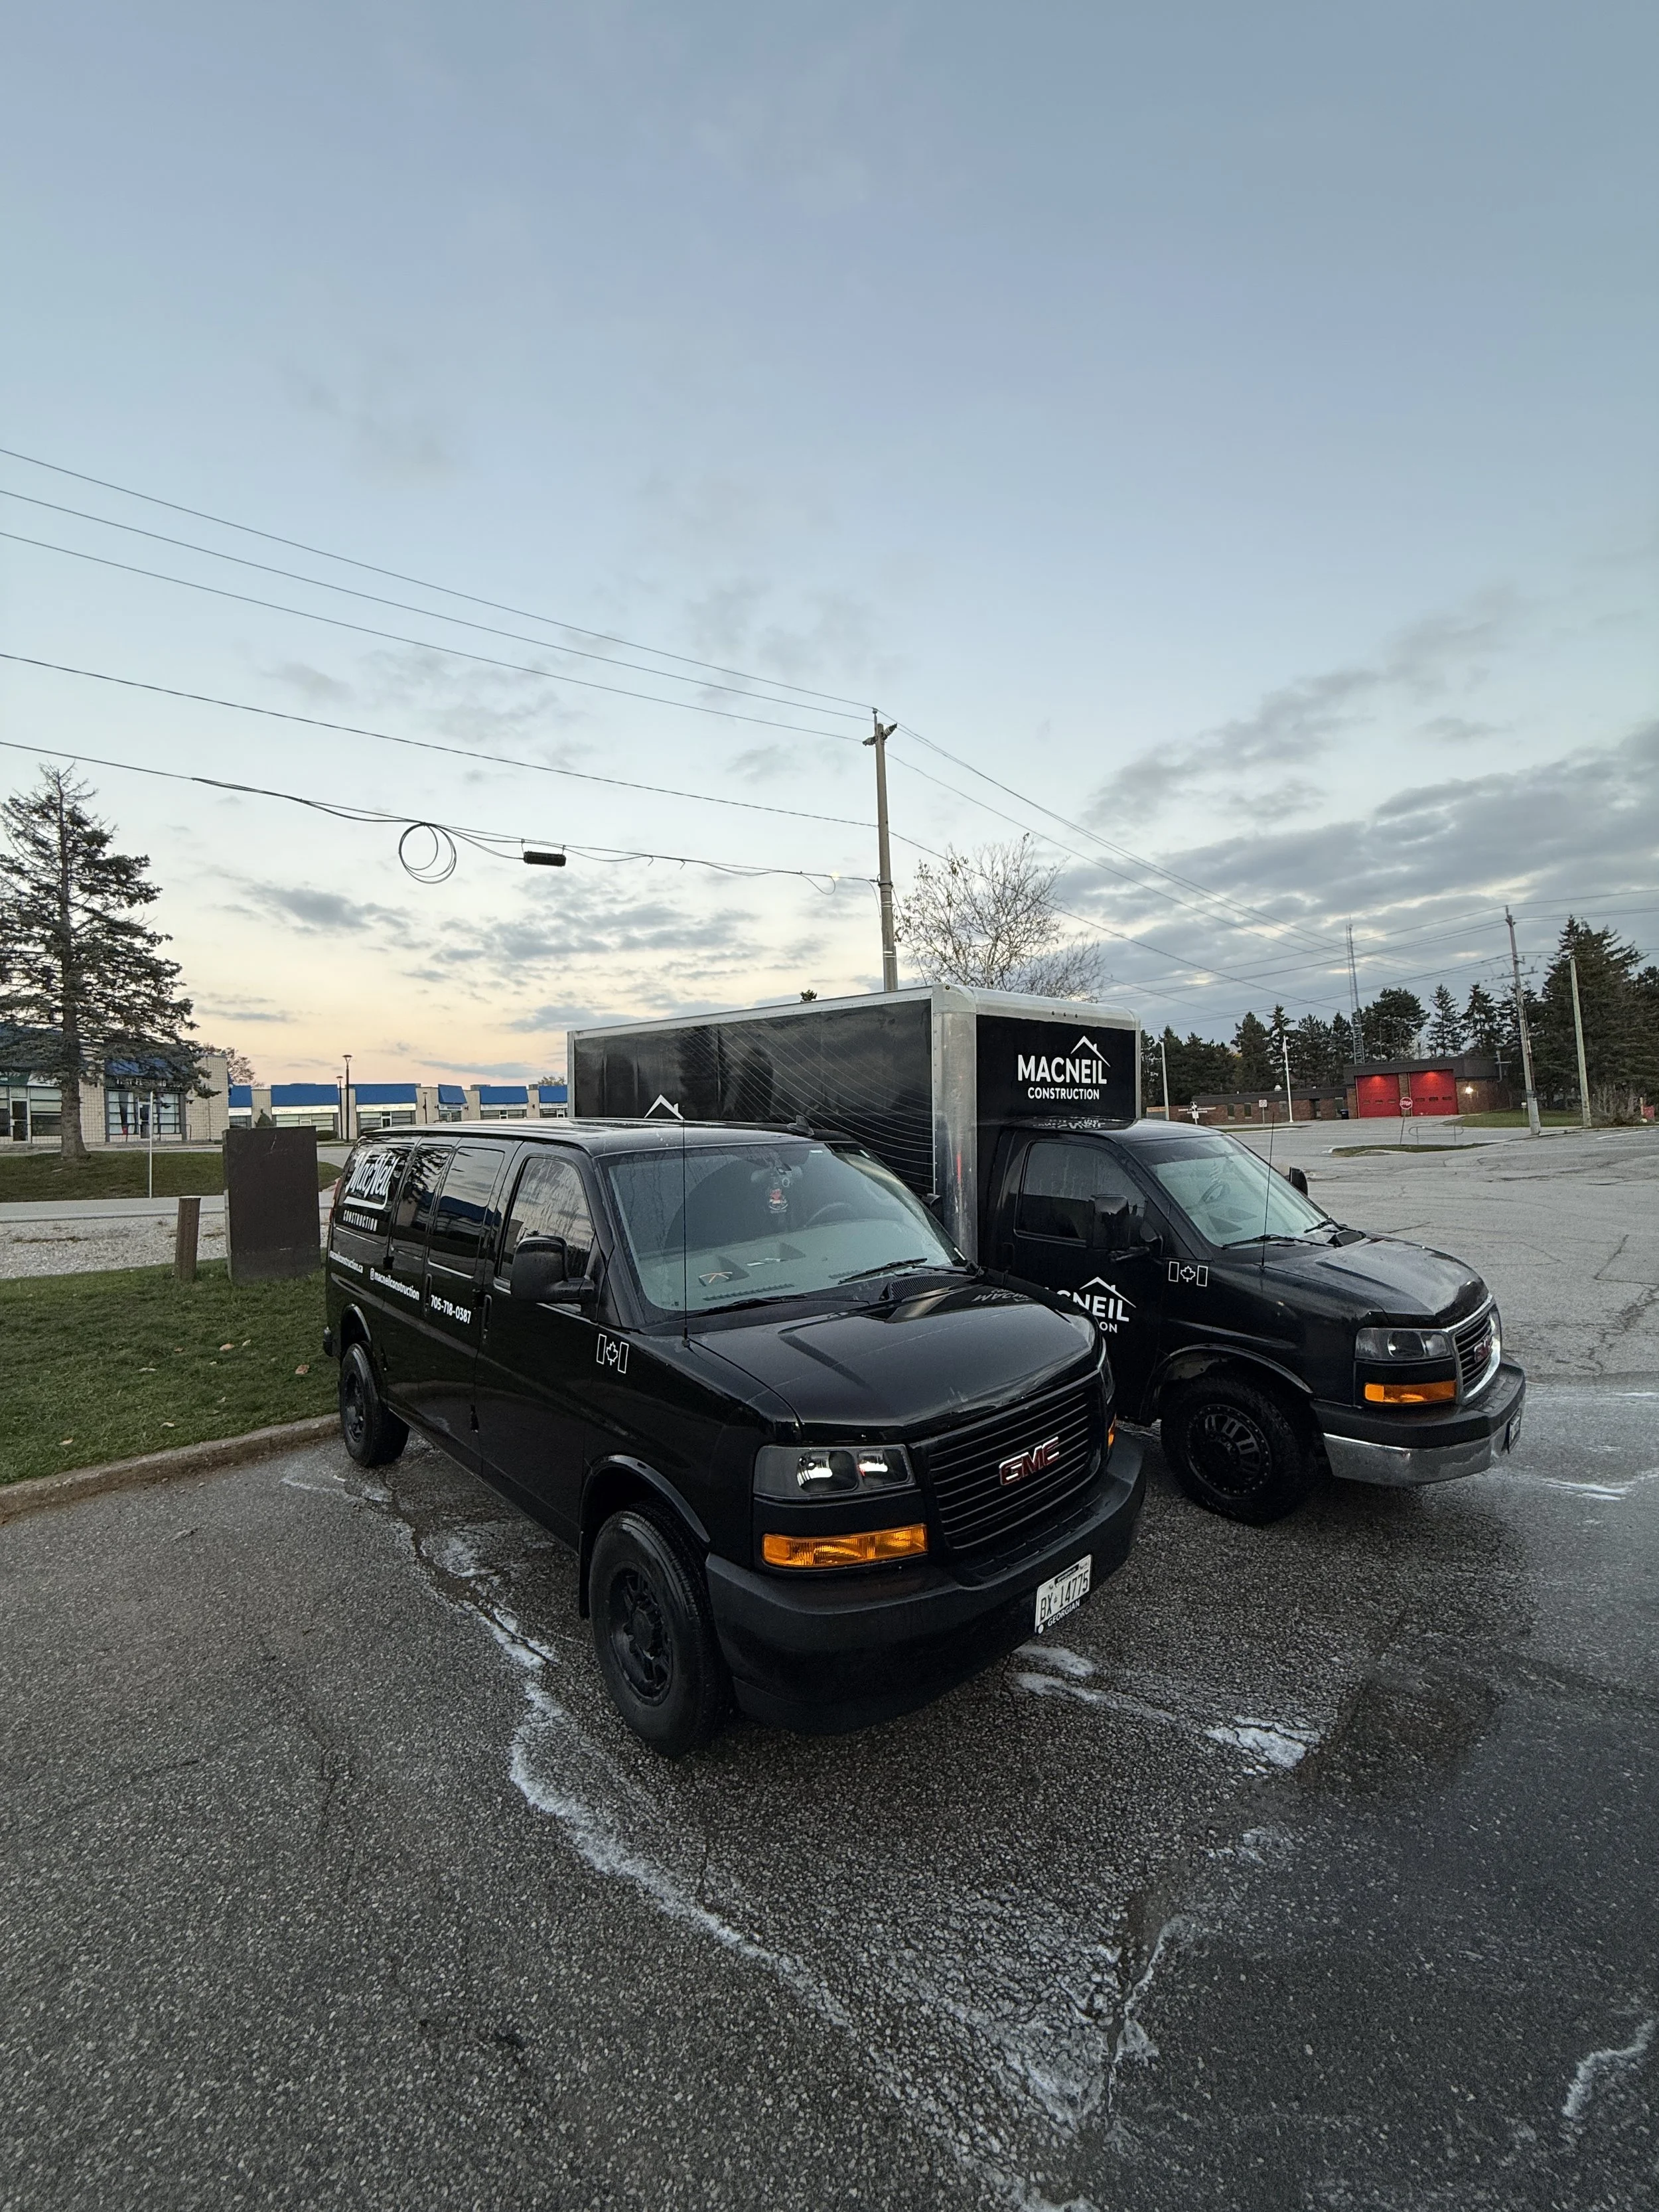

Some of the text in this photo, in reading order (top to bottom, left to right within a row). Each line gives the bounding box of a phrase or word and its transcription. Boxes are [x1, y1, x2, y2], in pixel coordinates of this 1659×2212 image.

[1017, 1054, 1108, 1084] MACNEIL
[1027, 1086, 1100, 1100] CONSTRUCTION
[345, 1150, 400, 1198] MacNeil
[343, 1209, 378, 1232] CONSTRUCTION
[370, 1267, 420, 1301] @macneilconstruction
[431, 1294, 472, 1324] 705-718-0387
[1045, 1287, 1129, 1322] NEIL
[998, 1436, 1060, 1486] GMC
[1047, 1598, 1080, 1627] GEORGIAN
